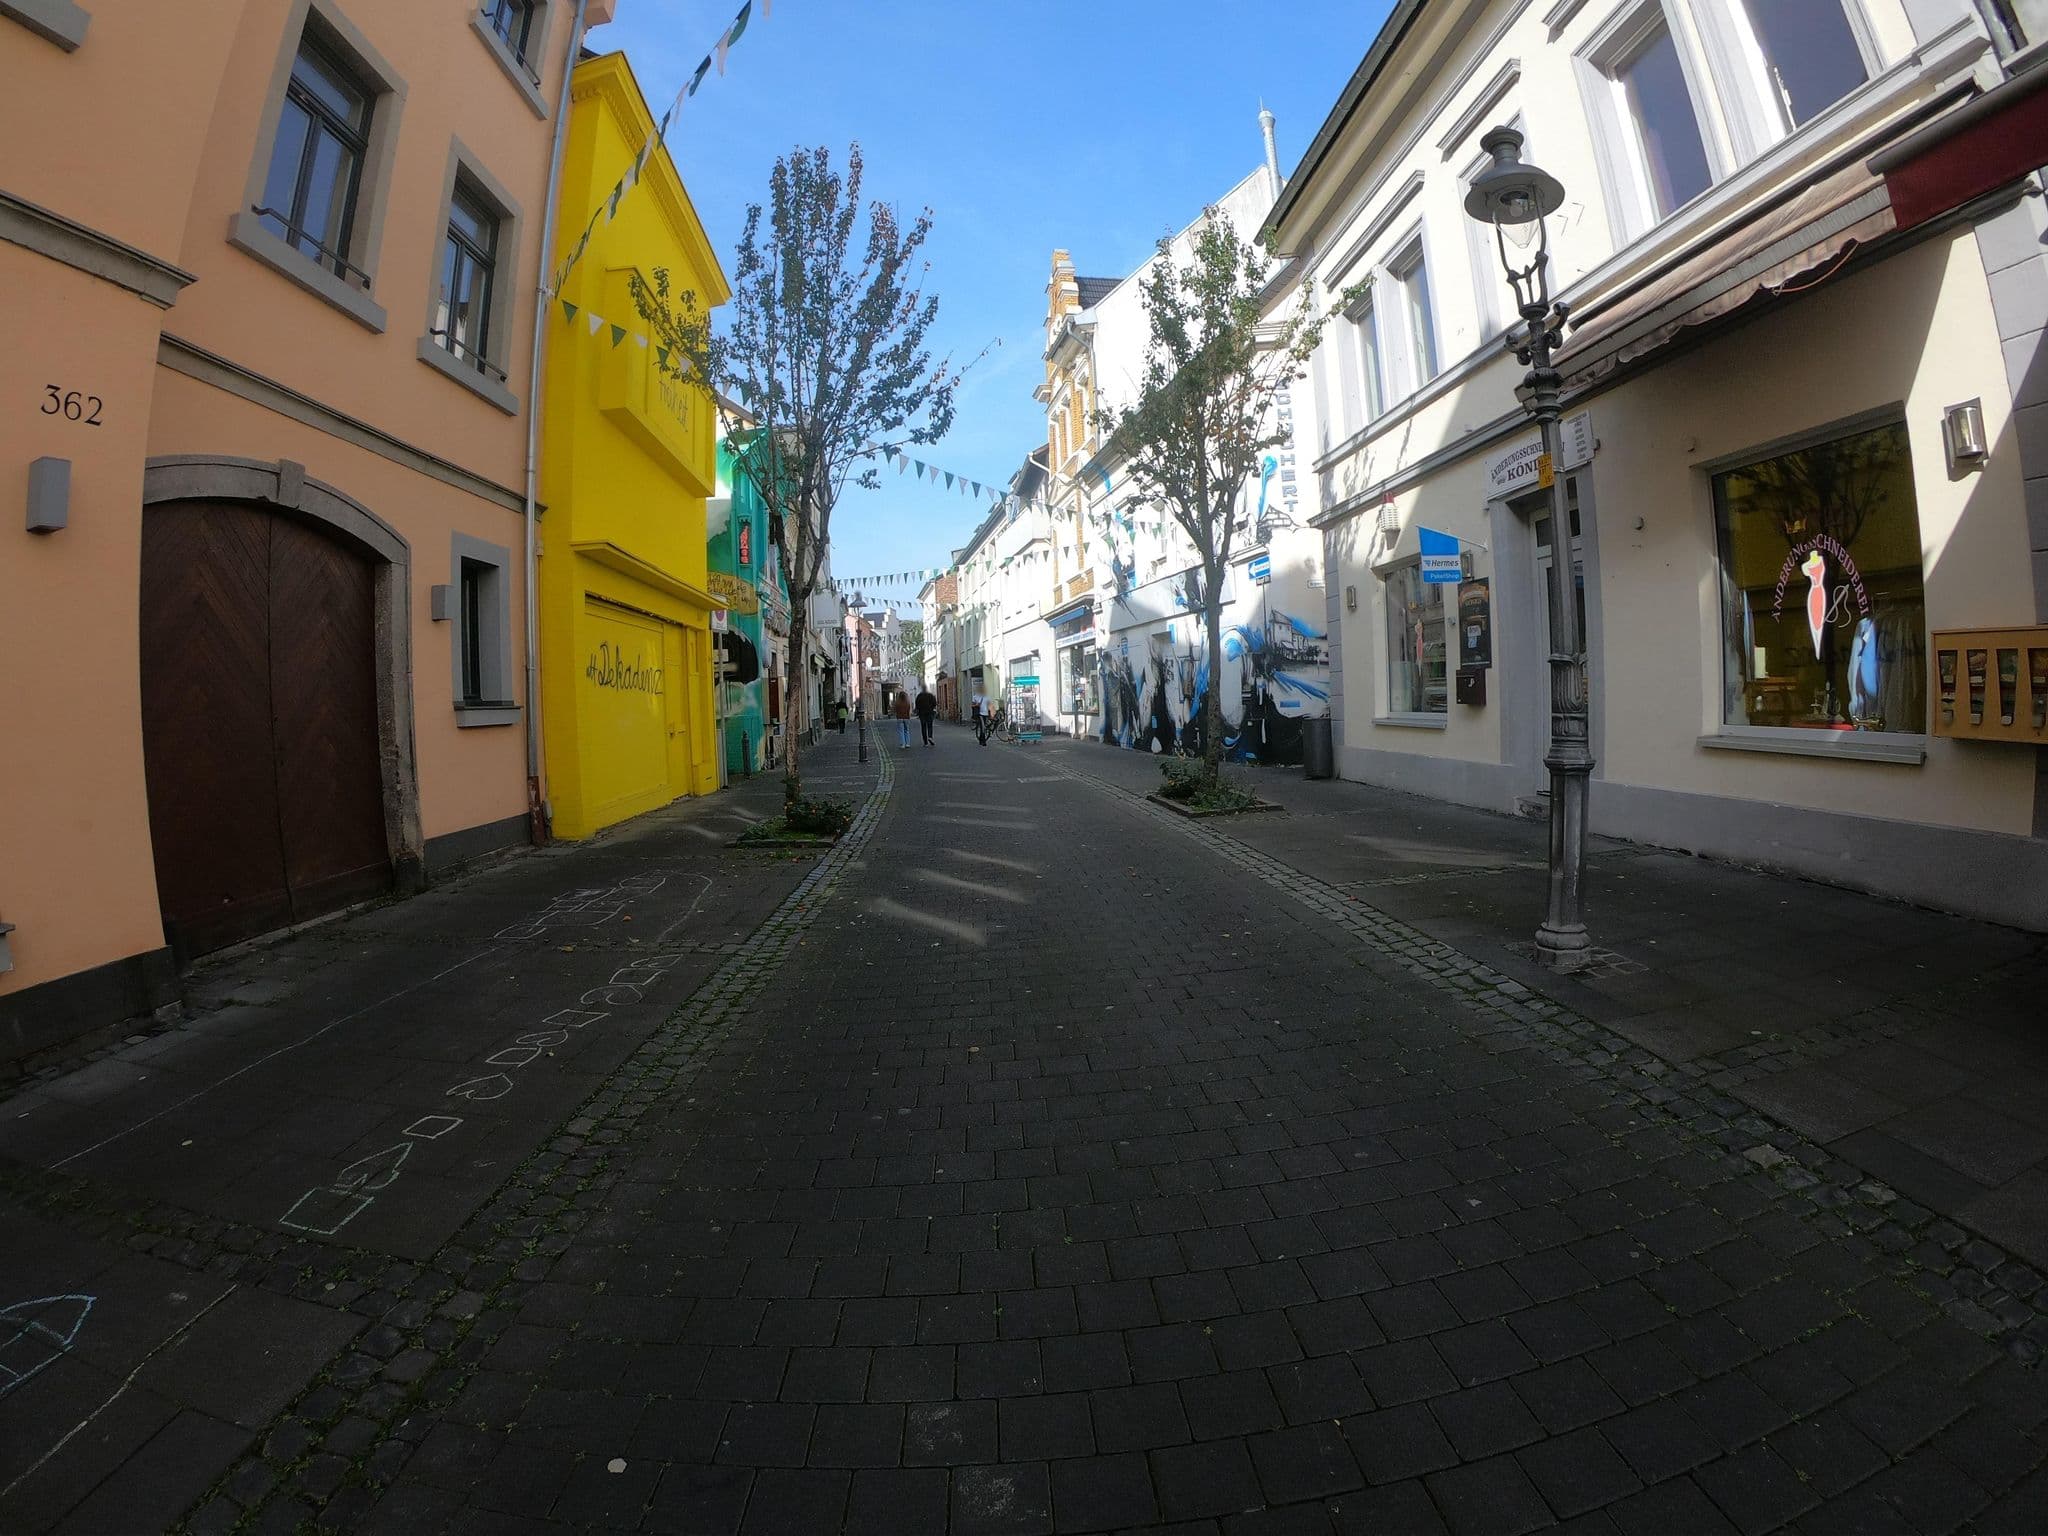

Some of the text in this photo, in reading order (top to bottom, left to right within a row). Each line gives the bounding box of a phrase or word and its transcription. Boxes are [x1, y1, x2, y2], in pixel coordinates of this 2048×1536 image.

[40, 384, 103, 426] 362
[1431, 559, 1459, 568] Hermes
[1772, 534, 1869, 623] ÄNDERUNGSSCHNEIDEREI
